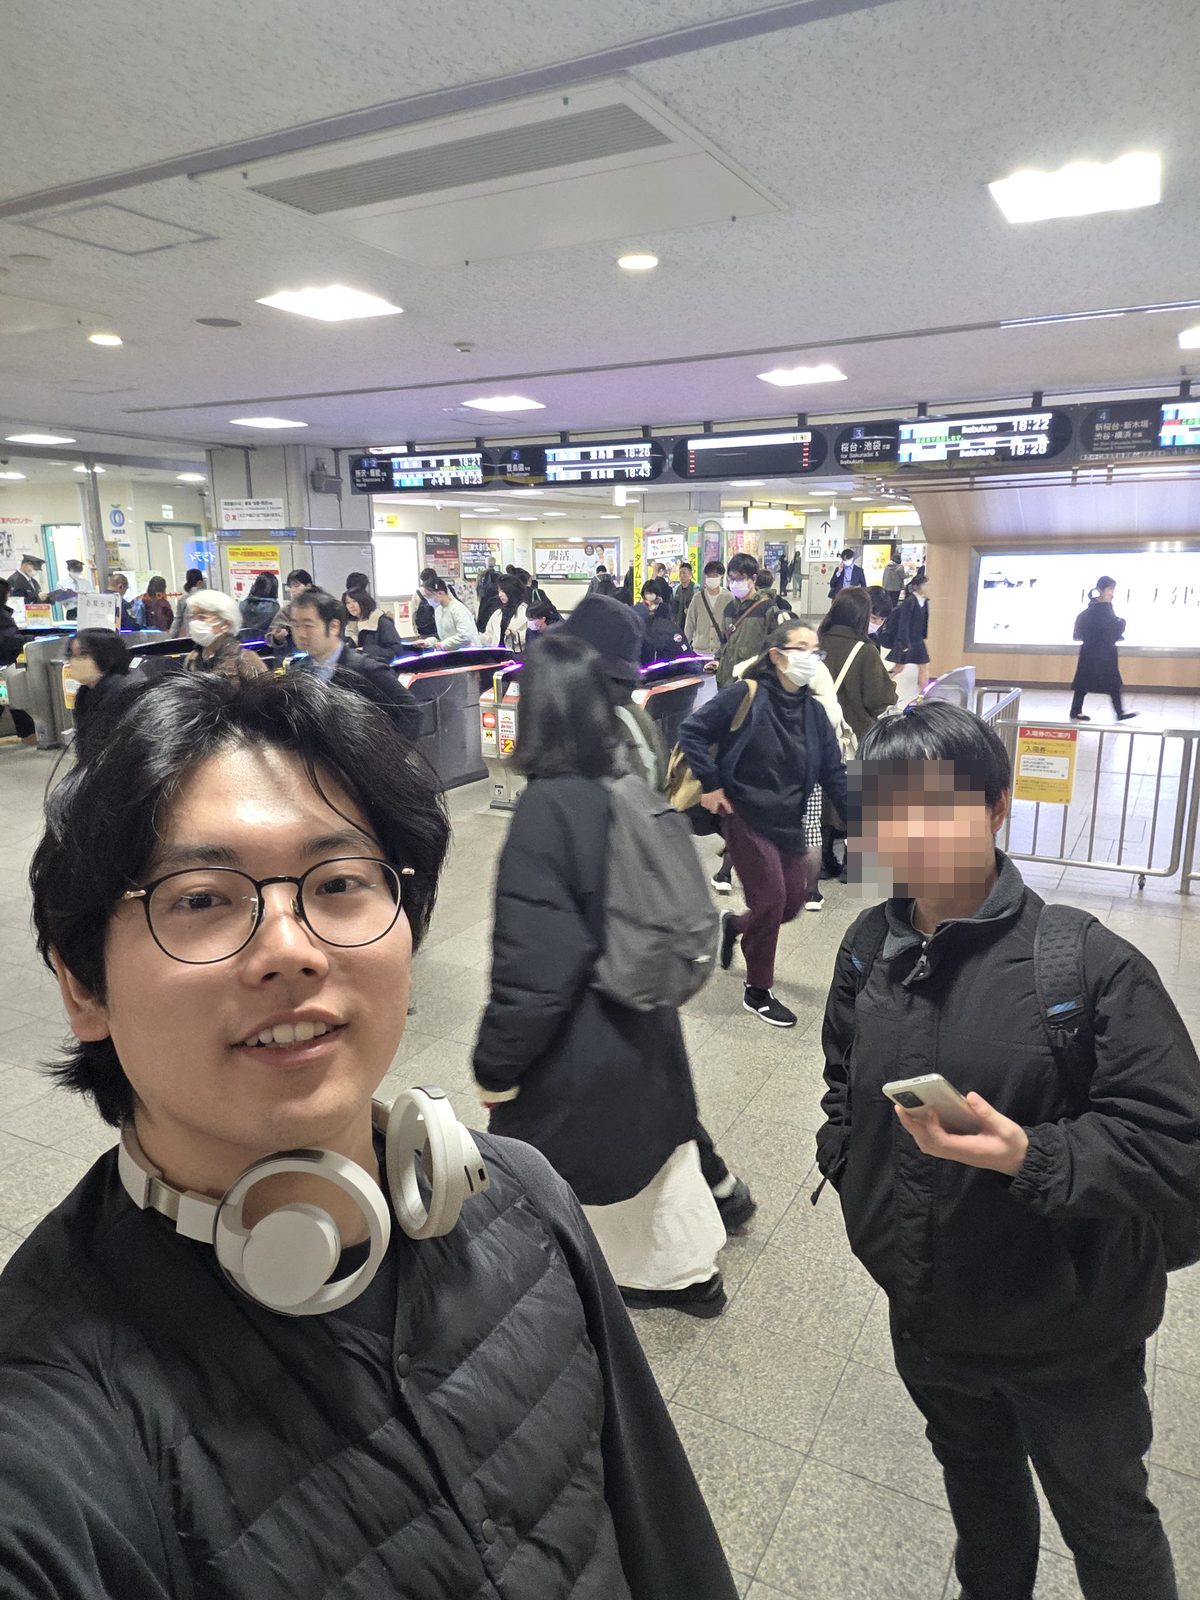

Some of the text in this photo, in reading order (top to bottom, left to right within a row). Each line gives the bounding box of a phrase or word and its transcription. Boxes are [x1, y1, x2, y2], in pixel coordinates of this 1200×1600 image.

[1099, 411, 1106, 421] 4
[1012, 417, 1049, 432] 18:22
[855, 429, 862, 439] 3
[841, 441, 881, 453] 桜台・池袋
[625, 467, 650, 478] 18:43
[460, 475, 482, 485] 18:23
